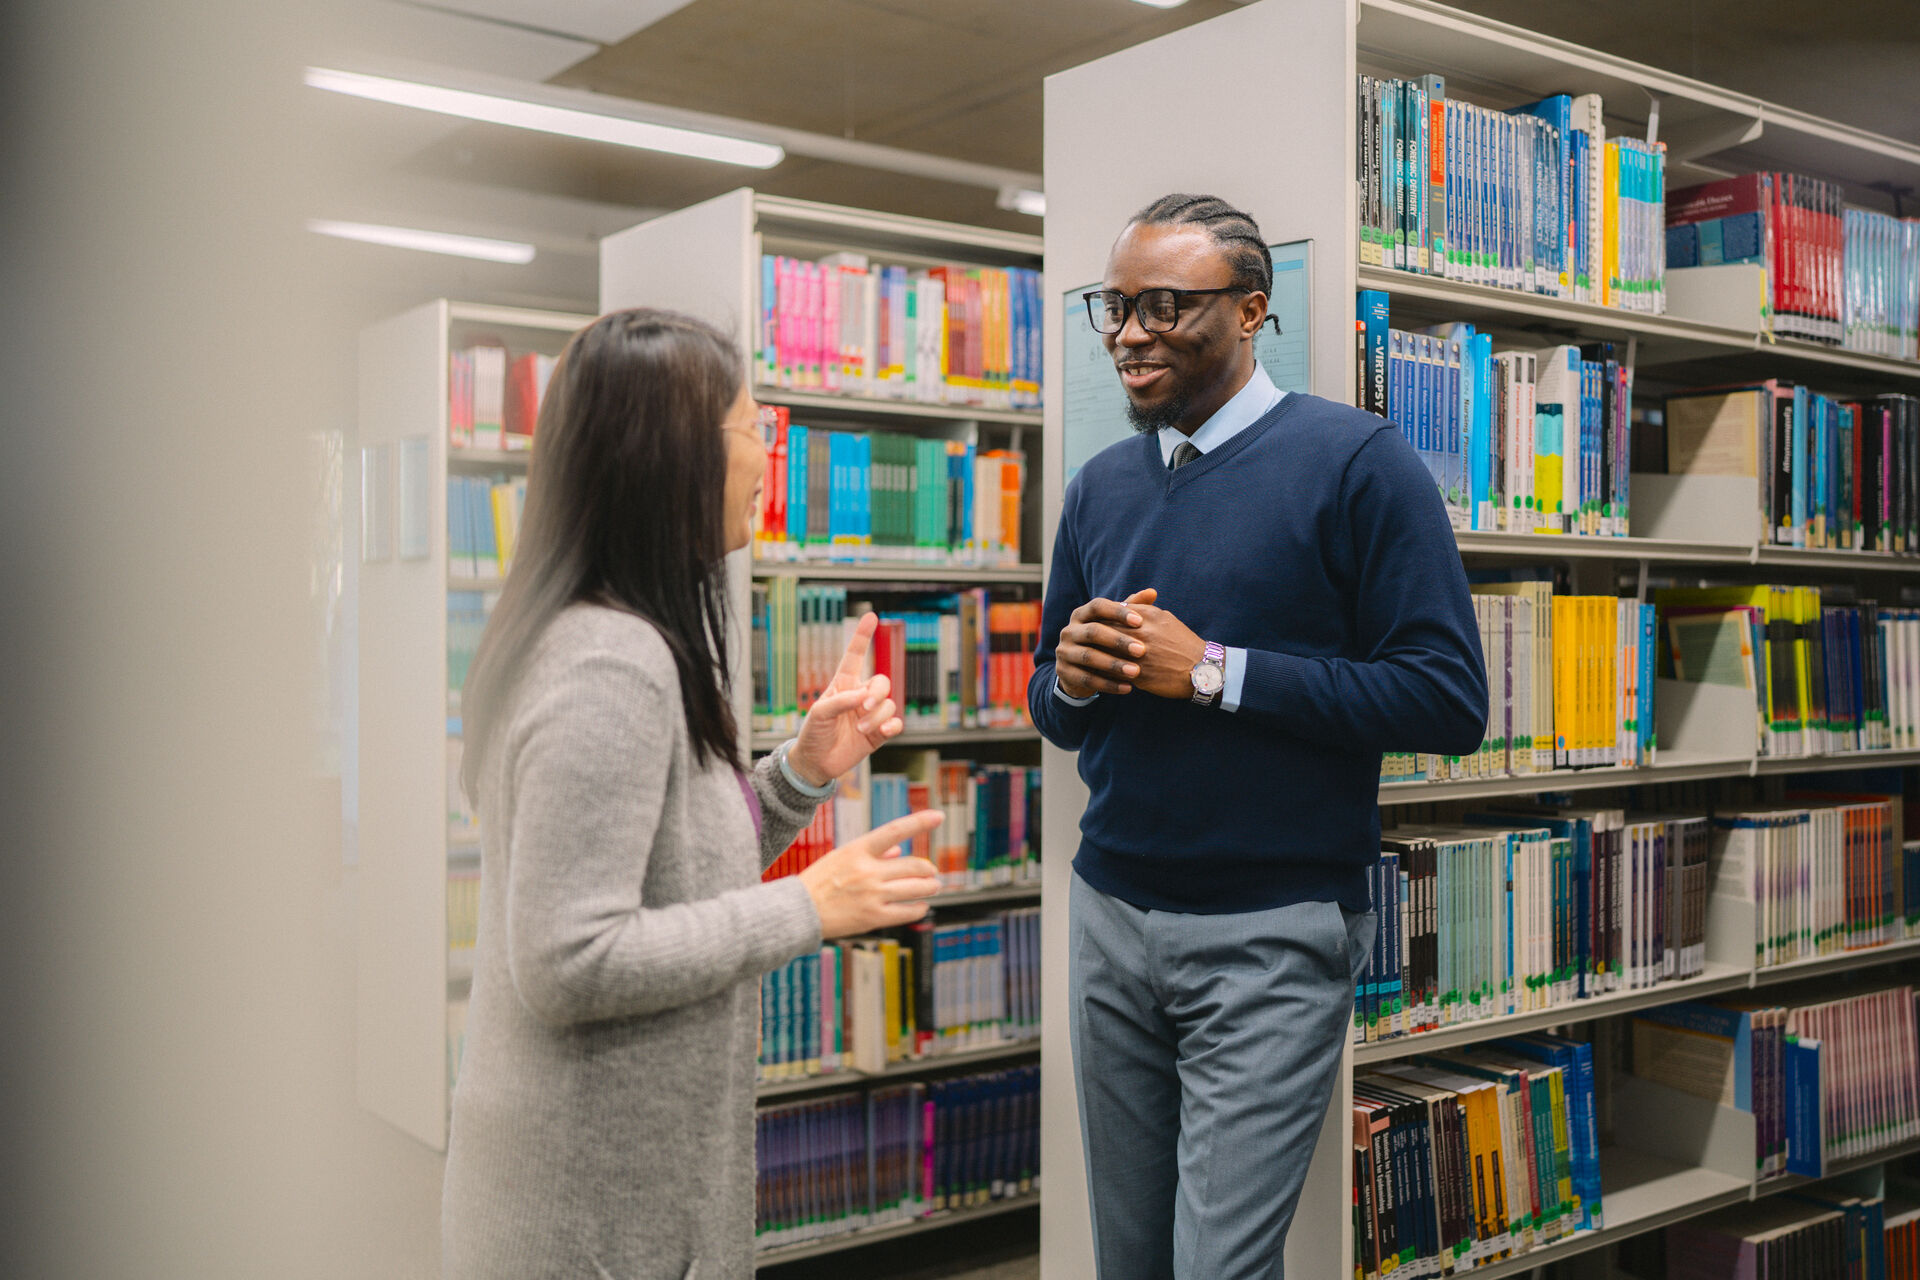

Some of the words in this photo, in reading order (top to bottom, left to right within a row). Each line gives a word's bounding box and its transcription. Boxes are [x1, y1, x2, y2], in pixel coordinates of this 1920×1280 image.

[1396, 139, 1404, 176] FORENSIC
[1409, 140, 1417, 177] FORENSIC
[1396, 177, 1404, 216] DENTISTRY
[1409, 179, 1417, 216] DENTISTRY
[1375, 346, 1384, 409] VIRTOPSY
[1462, 398, 1470, 433] Nursing
[1783, 406, 1792, 473] Epidemiology
[1461, 435, 1469, 496] Pharmacolog
[1375, 1136, 1383, 1164] Statistics
[1383, 1132, 1391, 1160] Statistics
[1377, 1174, 1385, 1214] Epidemiology
[1385, 1170, 1393, 1209] Epidemiology
